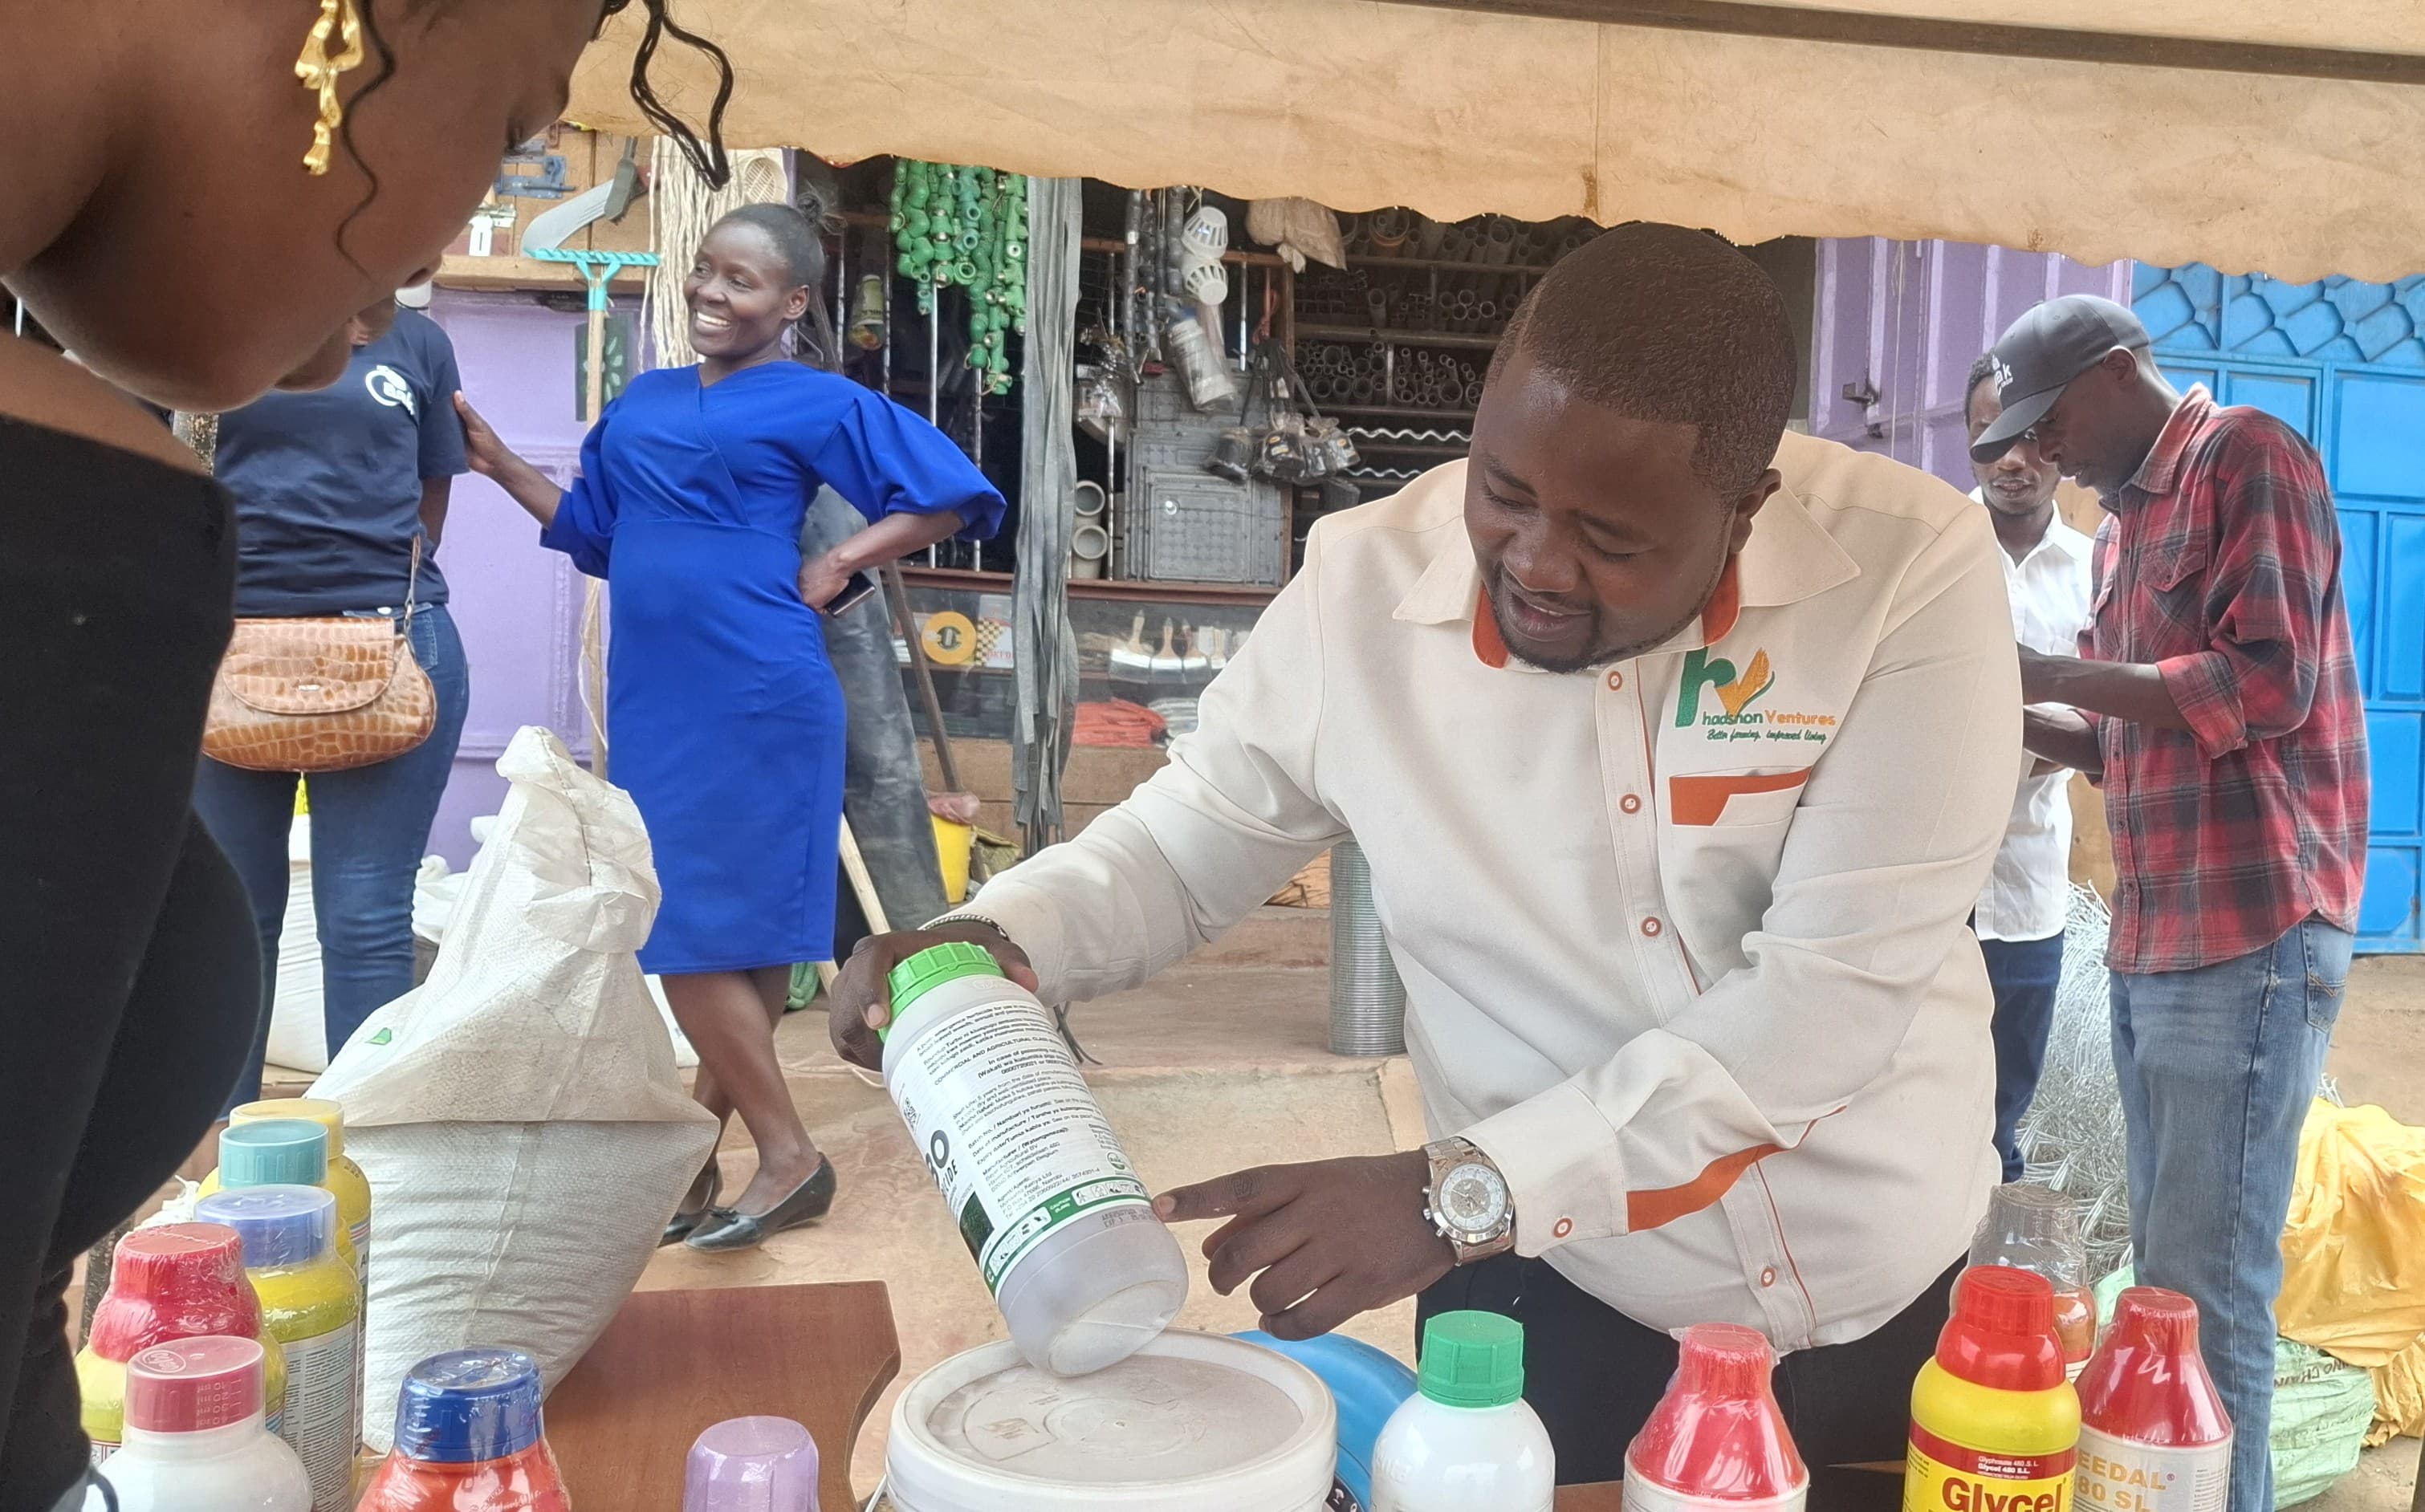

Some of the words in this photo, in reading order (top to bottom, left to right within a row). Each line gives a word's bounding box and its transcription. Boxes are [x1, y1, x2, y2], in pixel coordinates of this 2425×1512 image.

[1702, 711, 1763, 726] hadshon
[1765, 710, 1837, 726] Ventures
[1766, 730, 1801, 742] improved
[934, 1056, 970, 1085] COMMERCIAL
[972, 1049, 985, 1058] AND
[986, 1037, 1031, 1051] AGRICULTURAL
[996, 1053, 1011, 1061] case
[1023, 1177, 1041, 1189] Kenya
[1041, 1171, 1052, 1179] Ltd
[1978, 1462, 2001, 1472] Glycel
[2077, 1448, 2167, 1490] EEDAL
[1942, 1477, 2062, 1512] Glycel
[2077, 1476, 2106, 1502] 80
